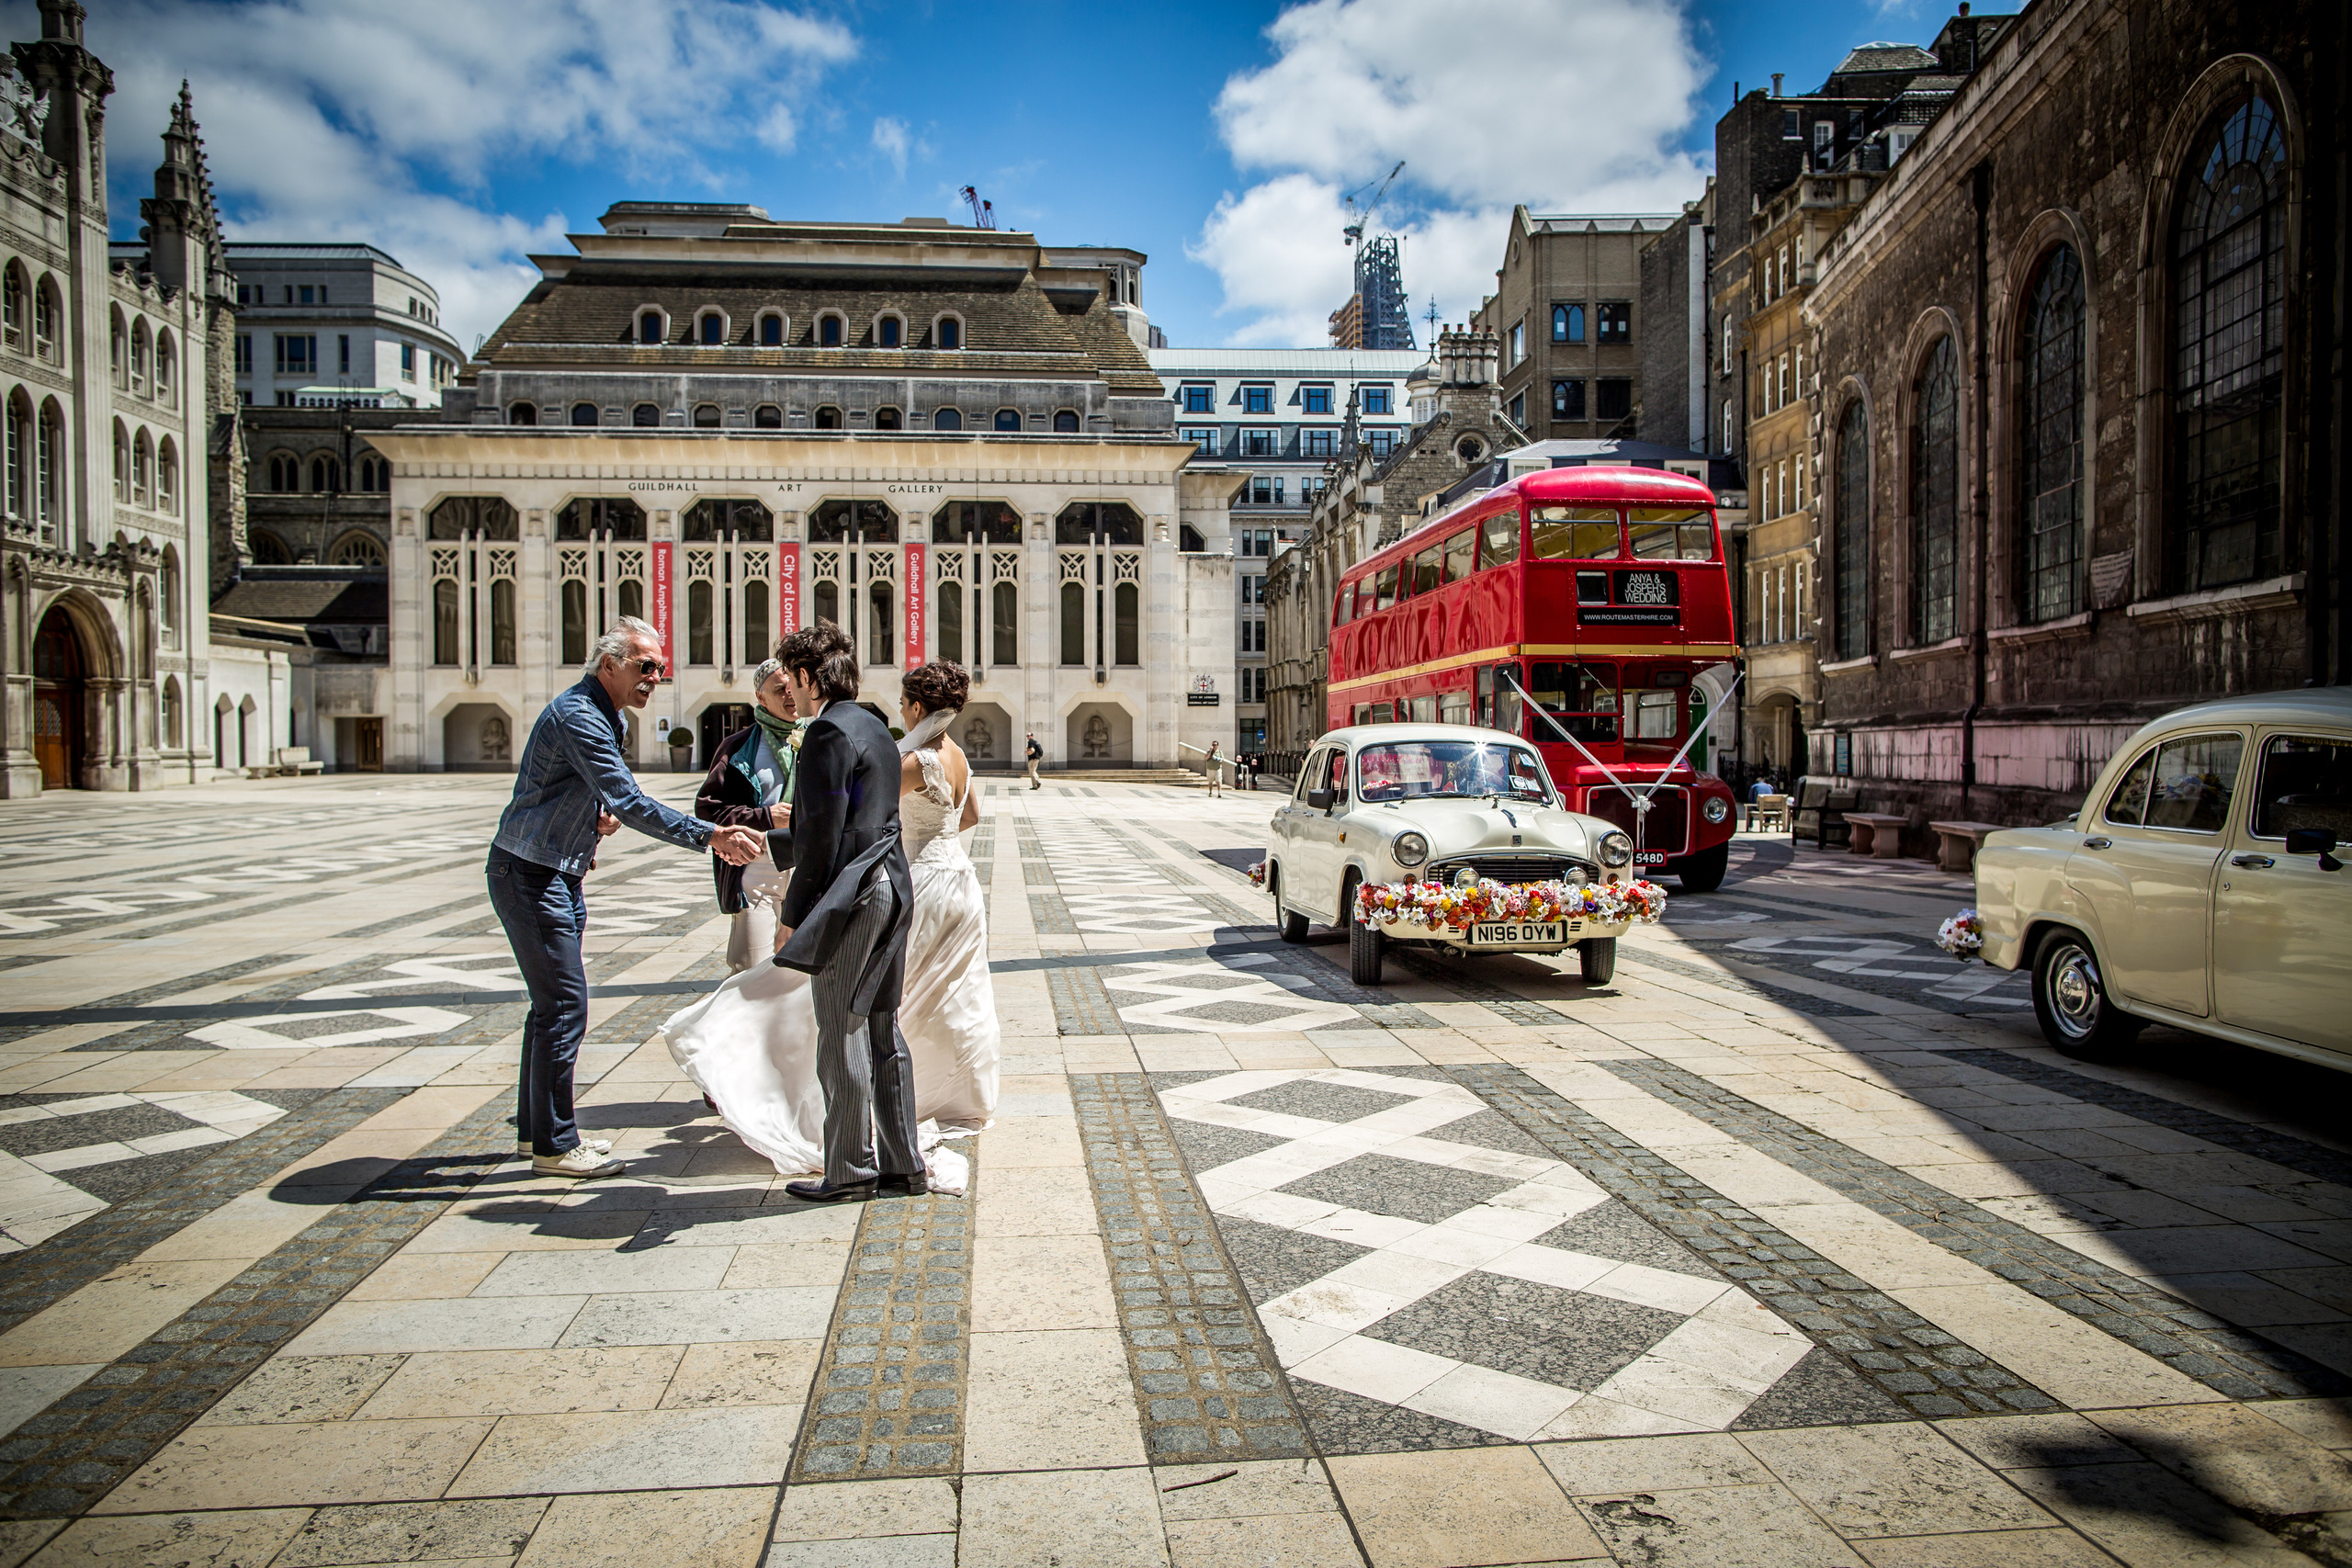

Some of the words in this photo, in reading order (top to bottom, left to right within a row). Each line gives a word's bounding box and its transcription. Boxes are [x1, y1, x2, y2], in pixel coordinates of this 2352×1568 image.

[628, 482, 698, 491] GUILDHALL
[778, 483, 802, 492] ART
[888, 484, 943, 493] GALLERY
[658, 548, 667, 581] Roman
[782, 554, 795, 579] City
[910, 552, 920, 593] Guildhall
[1629, 573, 1653, 583] ANYA
[1654, 573, 1660, 584] &
[784, 581, 796, 594] of
[1624, 582, 1666, 593] JOSPEH'S
[910, 595, 920, 610] Art
[1624, 592, 1667, 604] WEDDING
[657, 583, 667, 647] Amphitheatre
[784, 597, 796, 634] Londo
[909, 611, 920, 646] Gallery
[1635, 852, 1664, 863] 548D
[1477, 925, 1518, 942] N196
[1521, 925, 1556, 941] OYW
